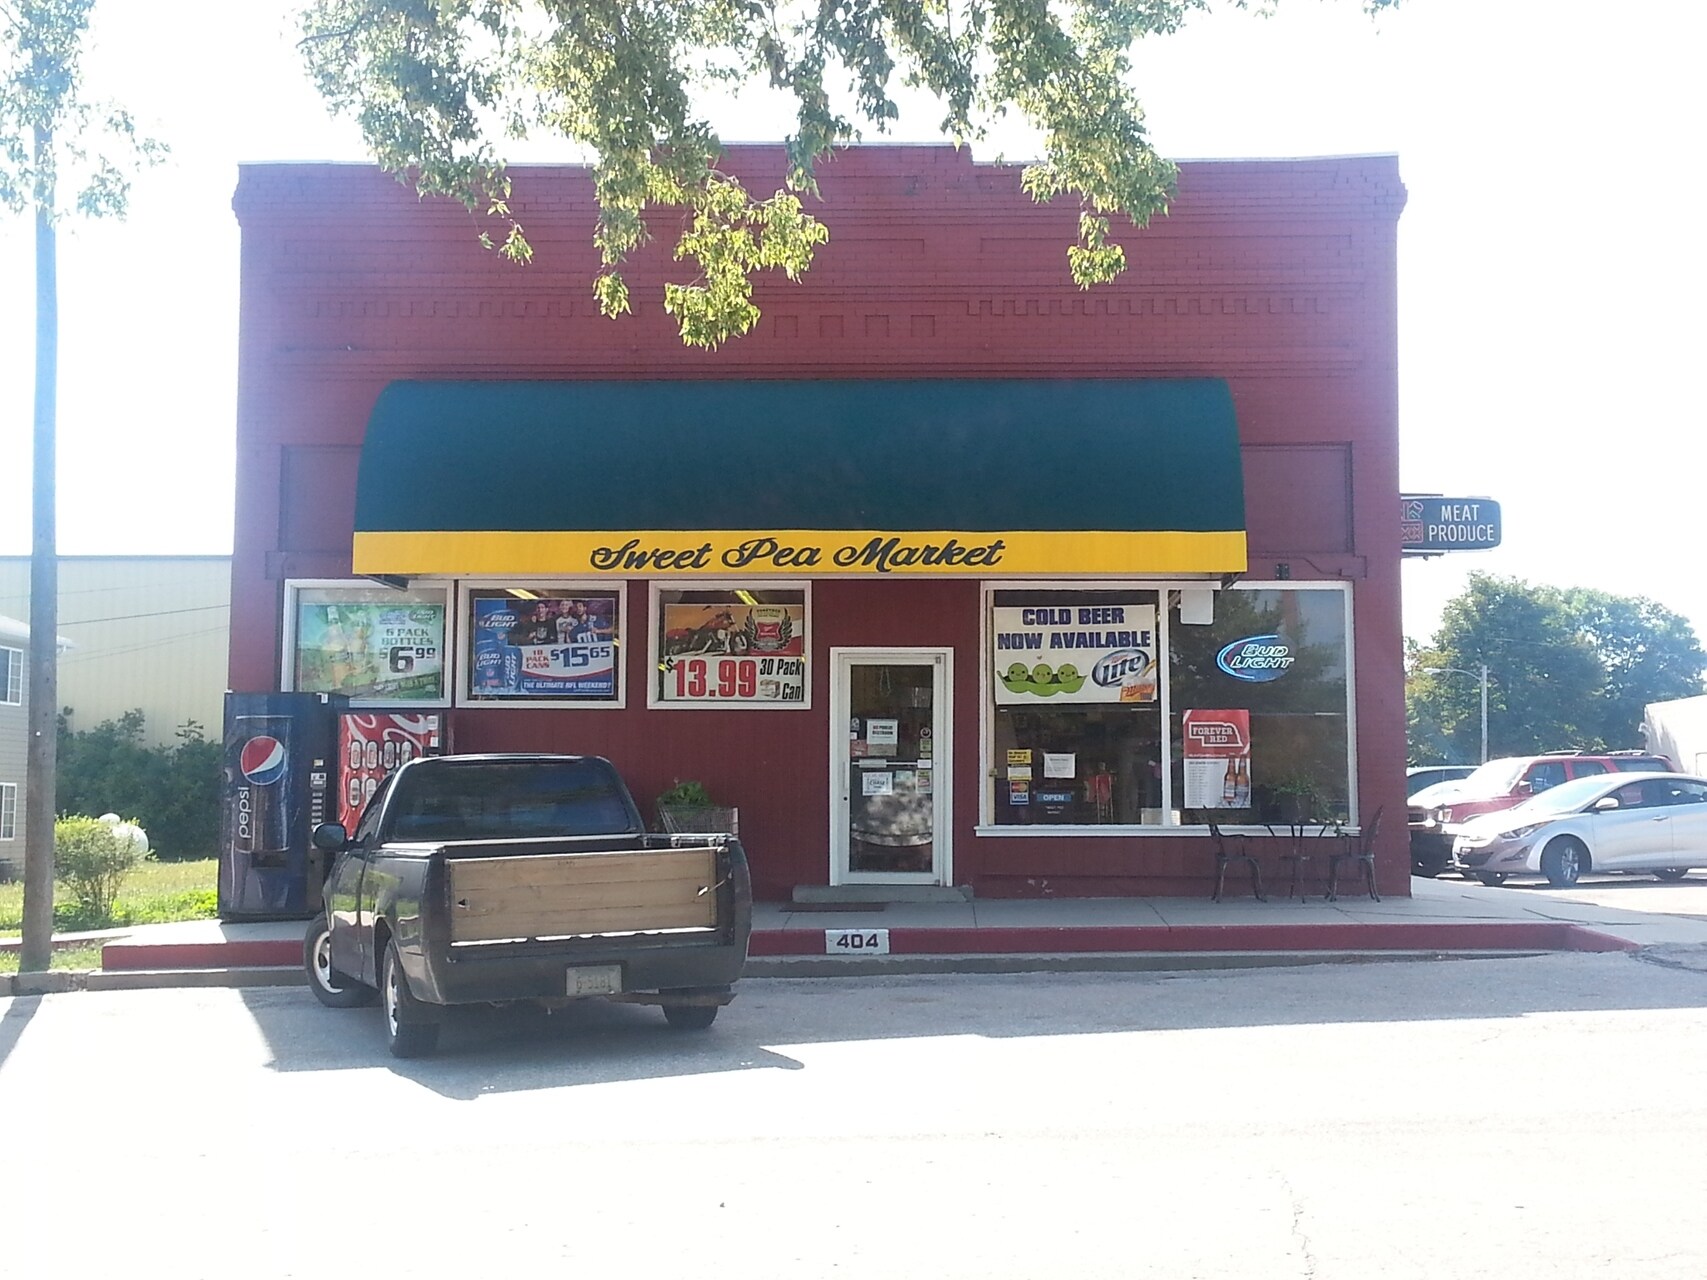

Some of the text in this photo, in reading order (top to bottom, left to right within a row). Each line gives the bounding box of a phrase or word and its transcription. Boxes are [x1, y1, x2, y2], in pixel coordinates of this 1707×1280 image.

[1441, 505, 1480, 522] MEAT
[1428, 524, 1495, 542] PRODUCE
[590, 537, 1006, 573] Sweet Pea Market
[1022, 607, 1125, 625] COLD BEER
[386, 628, 430, 637] 6 PACK
[997, 631, 1151, 649] NOW AVAILABLE
[381, 637, 434, 646] BOTTLES
[1241, 644, 1289, 657] BUD
[476, 660, 502, 670] LIGHT
[509, 652, 517, 686] LIGHT
[760, 658, 801, 676] 30 Pack
[1101, 655, 1142, 685] Lite
[1230, 657, 1295, 669] LIGHT
[781, 683, 801, 700] Can
[1193, 727, 1233, 735] FOREVER
[1209, 735, 1228, 743] RED
[238, 786, 252, 839] pepsi
[836, 933, 879, 949] 404
